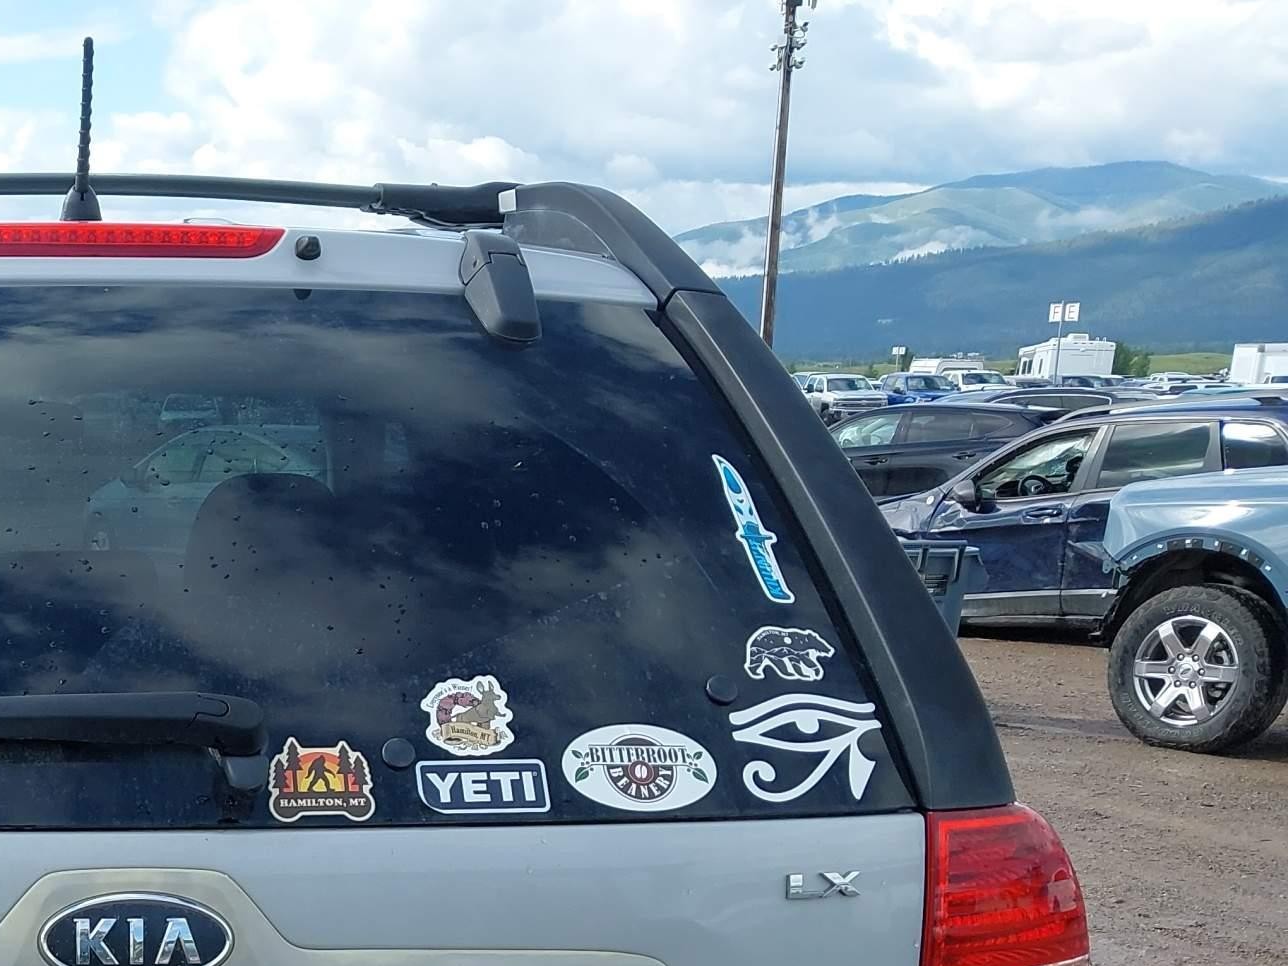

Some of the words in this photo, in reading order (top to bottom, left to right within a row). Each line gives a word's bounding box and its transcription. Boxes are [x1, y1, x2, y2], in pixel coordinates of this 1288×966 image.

[1053, 305, 1062, 320] F
[1068, 305, 1076, 319] E
[480, 732, 490, 742] MT
[589, 747, 687, 764] BITTERROOT
[425, 771, 536, 803] YETI
[609, 767, 672, 798] BEANERY
[279, 797, 347, 809] HAMILTON,
[348, 798, 366, 807] MT
[785, 870, 861, 900] LX
[73, 917, 202, 966] KIA
